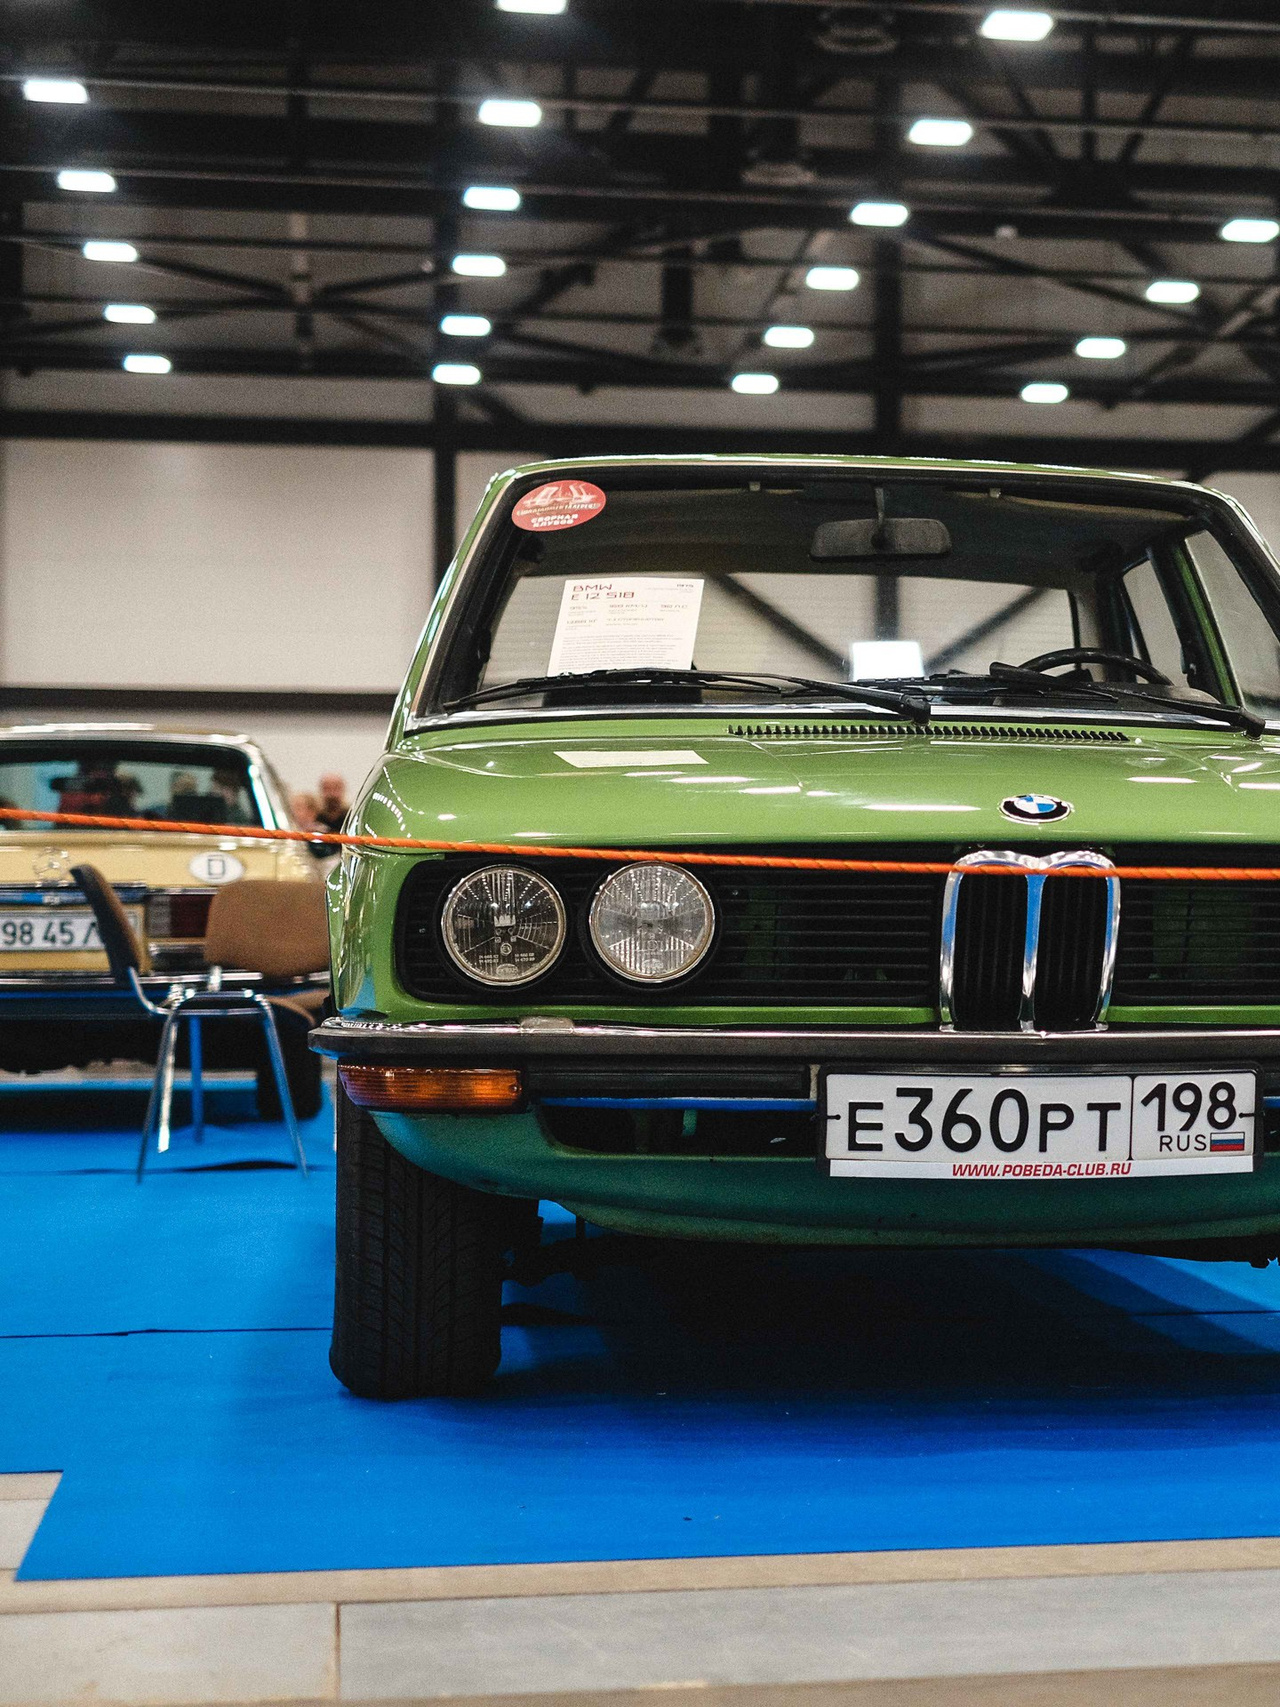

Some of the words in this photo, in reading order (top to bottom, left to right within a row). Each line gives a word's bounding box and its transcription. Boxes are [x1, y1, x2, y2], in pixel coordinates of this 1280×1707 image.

[606, 591, 635, 599] 518
[43, 921, 75, 945] 45
[1141, 1081, 1237, 1132] 198
[1159, 1134, 1207, 1152] RUS
[952, 1162, 1132, 1177] WWW.POBEDA-CLUB.RU
